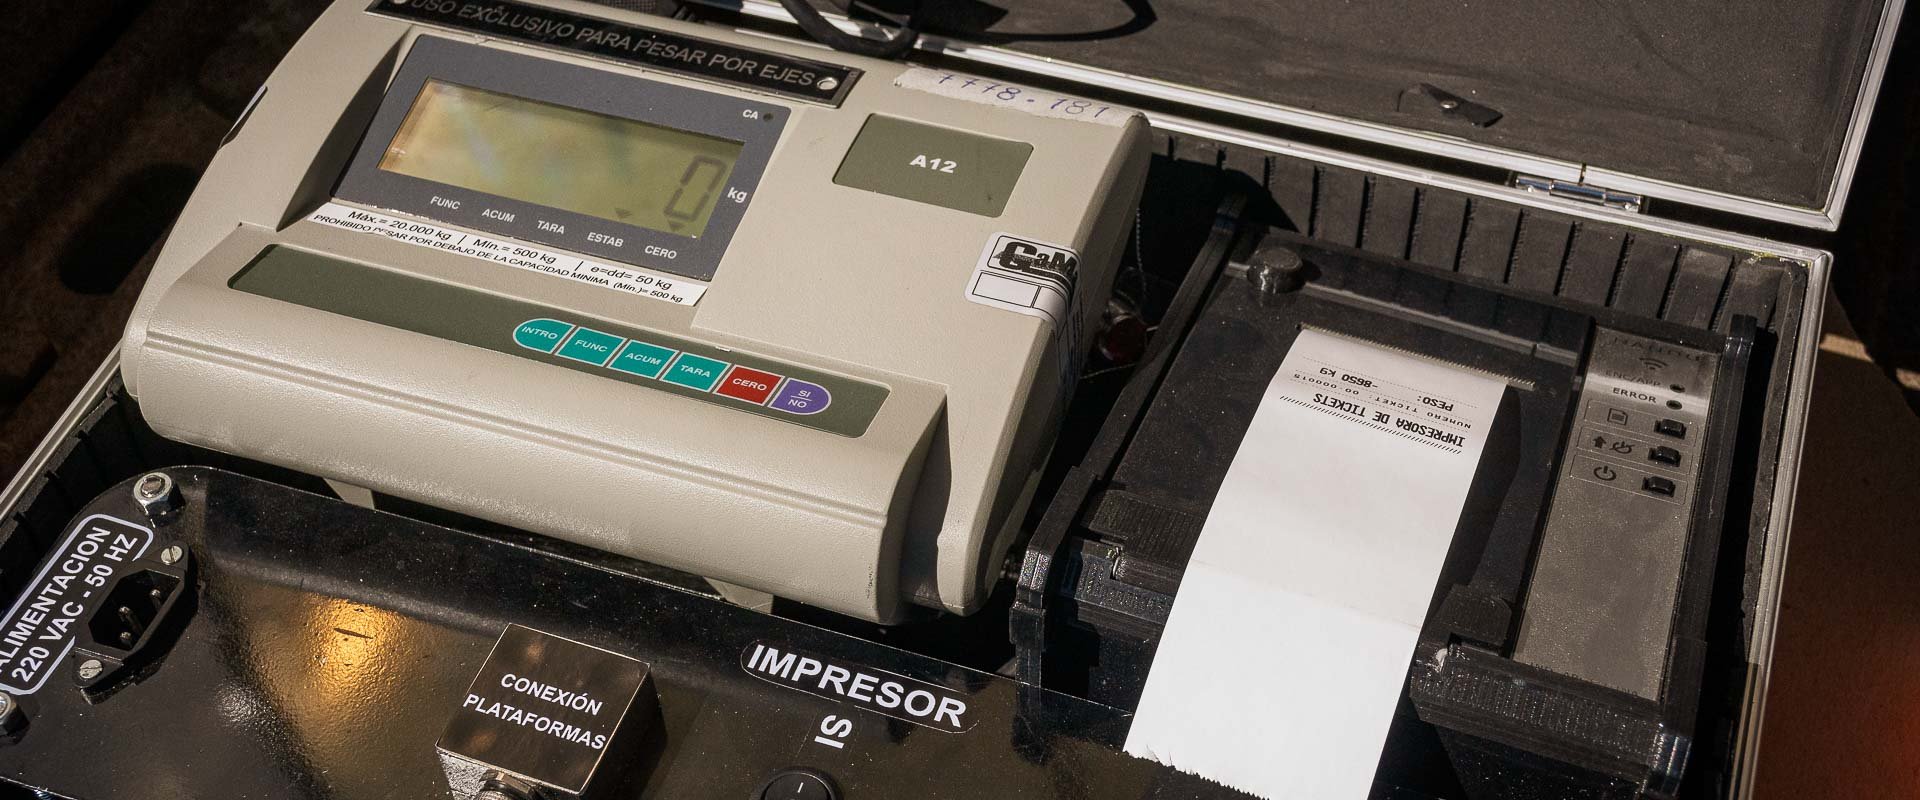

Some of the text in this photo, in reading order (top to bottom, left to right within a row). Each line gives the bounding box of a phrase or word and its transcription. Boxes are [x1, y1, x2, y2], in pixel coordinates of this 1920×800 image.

[411, 0, 816, 86] USO EXCLUSIVO PARA PESAR POR EJES
[743, 109, 759, 120] CA
[909, 154, 957, 174] A12
[664, 155, 727, 222] 0
[727, 187, 747, 203] kg
[430, 195, 460, 210] FUNC
[482, 208, 515, 223] ACUM
[537, 220, 565, 234] TARA
[587, 232, 624, 247] ESTAB
[313, 214, 372, 232] PROHIBIDO
[408, 236, 432, 246] POR
[433, 241, 475, 255] DEBAJO
[476, 250, 492, 259] DE
[494, 254, 507, 263] LA
[508, 258, 569, 276] CAPACIDAD
[650, 290, 669, 299] 500
[670, 294, 683, 303] kg
[389, 220, 434, 235] 20.000
[435, 230, 452, 241] kg
[512, 248, 538, 259] 500
[539, 253, 557, 264] kg
[635, 275, 654, 285] 50
[655, 279, 672, 290] kg
[644, 245, 677, 259] CERO
[521, 326, 558, 340] INTRO
[574, 339, 608, 353] FUNC
[625, 352, 661, 365] ACUM
[681, 364, 711, 378] TARA
[732, 378, 768, 391] CERO
[1341, 374, 1378, 388] -8650
[1613, 387, 1657, 403] ERROR
[788, 399, 807, 408] NO
[1417, 396, 1453, 411] PESO:
[1313, 393, 1465, 448] IMPRESORA DE TICKETS
[1427, 412, 1471, 429] NUMERO
[11, 646, 50, 682] 220
[39, 601, 84, 640] VAC
[84, 564, 113, 587] 50
[104, 533, 138, 561] HZ
[747, 644, 967, 728] IMPRESOR
[501, 673, 603, 716] CONEXIÓN
[463, 693, 606, 749] PLATAFORMAS
